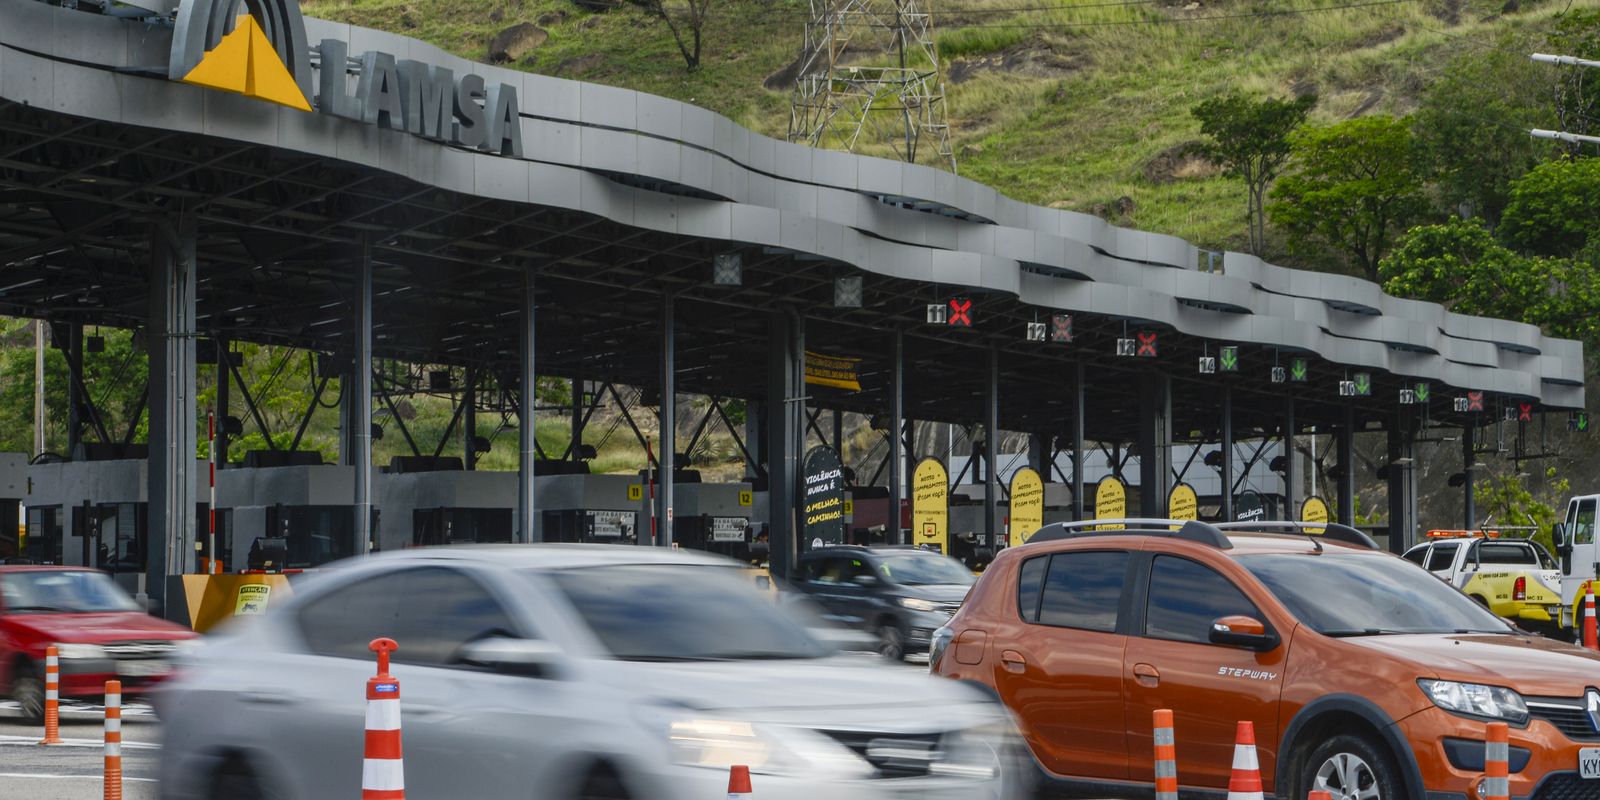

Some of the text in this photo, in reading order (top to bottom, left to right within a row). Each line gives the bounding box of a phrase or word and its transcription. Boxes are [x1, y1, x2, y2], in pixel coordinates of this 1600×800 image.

[319, 38, 523, 158] LAMSA
[928, 304, 946, 322] 11
[1028, 323, 1046, 340] 12
[806, 469, 841, 484] VIOLÊNCIA
[631, 487, 639, 497] 11
[808, 483, 828, 495] NUNCA
[741, 494, 750, 503] 12
[806, 497, 840, 513] O MELHOR
[807, 511, 840, 524] CAMINHO!
[1237, 508, 1264, 520] VIOLÊNCIA
[1218, 666, 1277, 680] STEPWAY
[1583, 758, 1600, 774] KY
